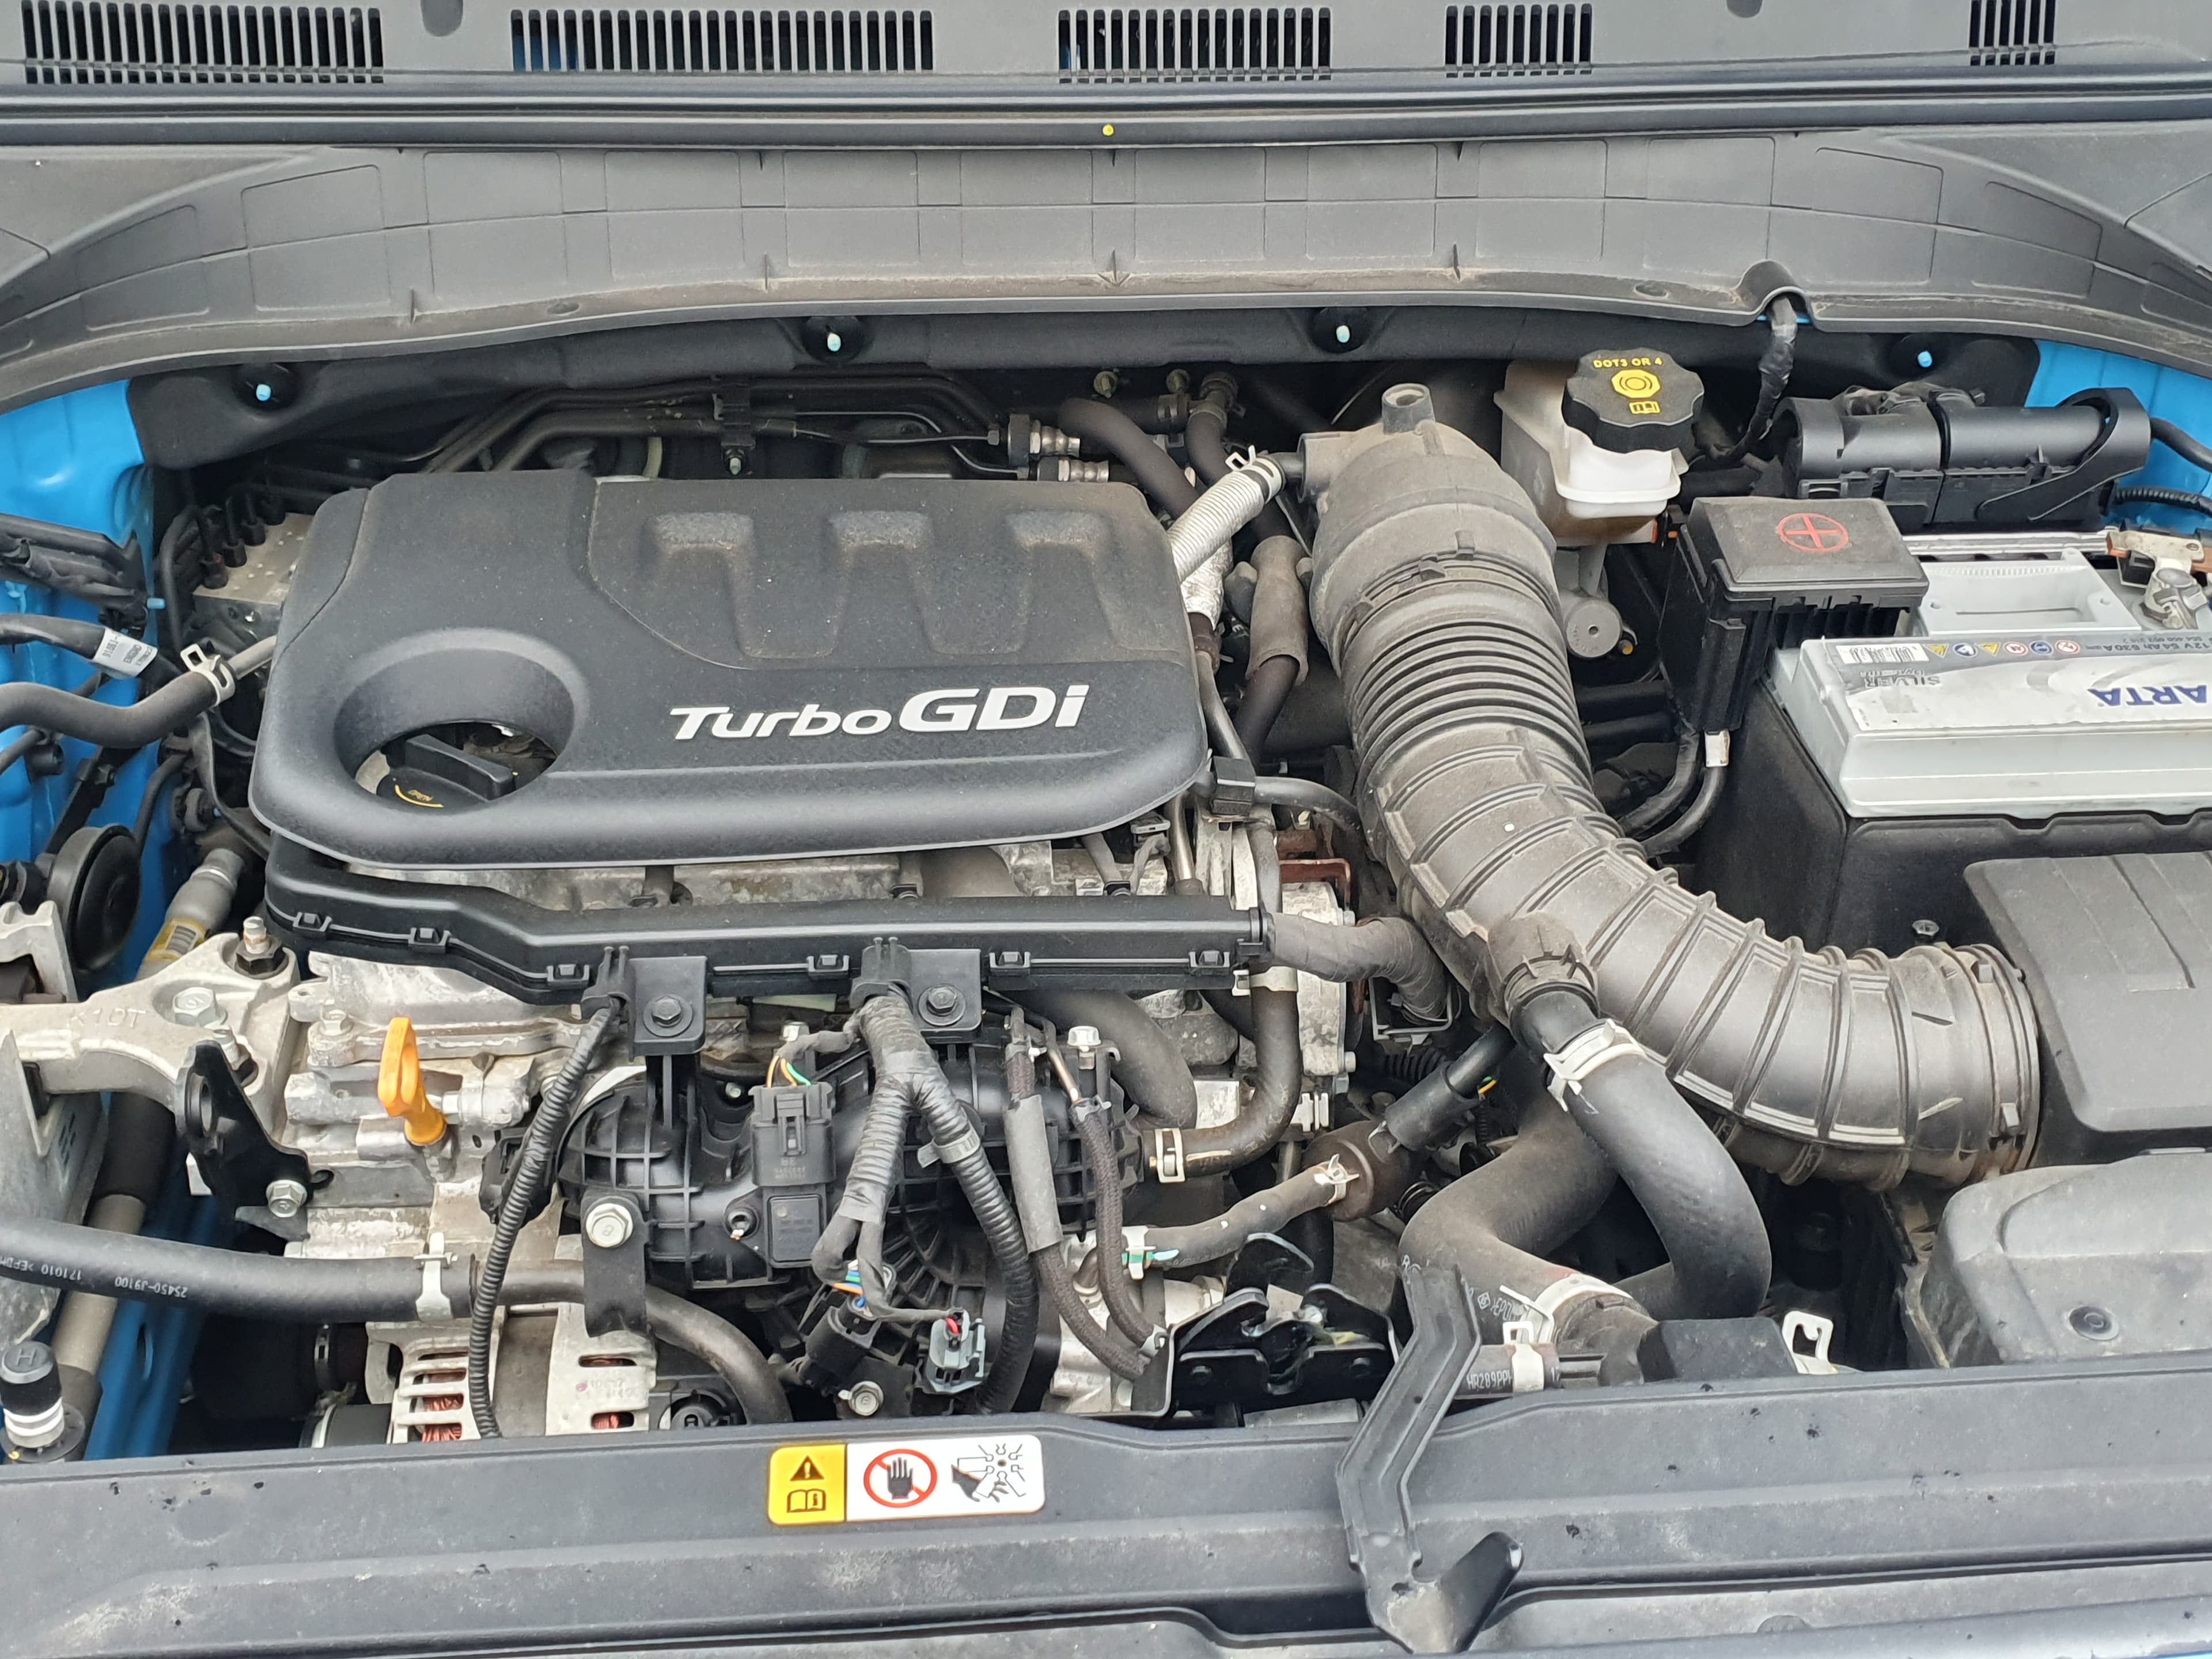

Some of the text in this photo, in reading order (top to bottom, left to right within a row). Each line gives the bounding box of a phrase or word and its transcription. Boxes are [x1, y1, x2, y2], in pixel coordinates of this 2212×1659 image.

[1593, 357, 1662, 368] DOT3 OR 4
[670, 684, 1090, 740] Turbo GDi
[16, 1348, 38, 1367] H
